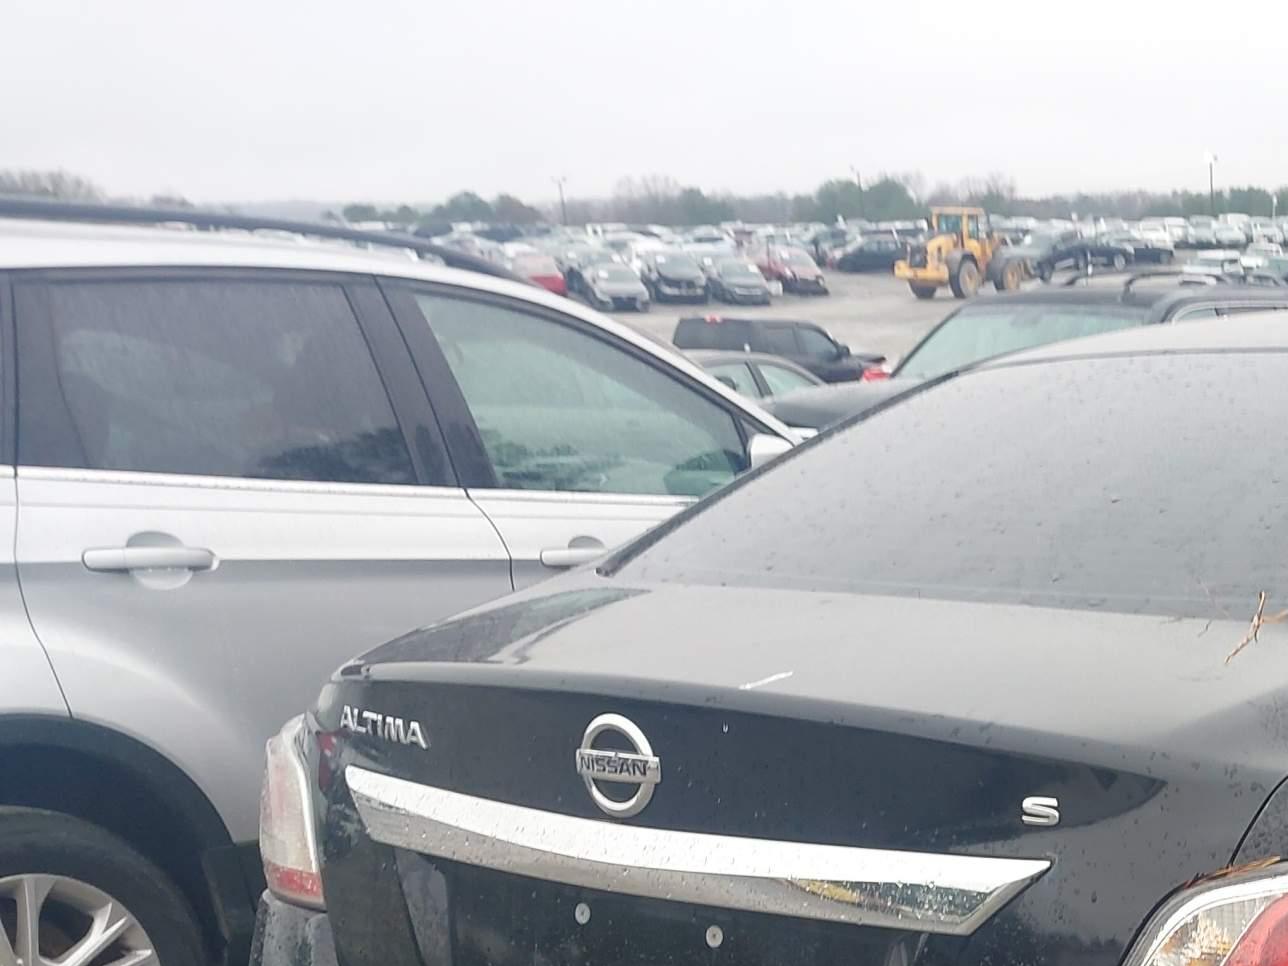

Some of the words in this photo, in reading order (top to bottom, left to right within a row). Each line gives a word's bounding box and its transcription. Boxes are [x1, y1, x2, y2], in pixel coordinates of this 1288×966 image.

[340, 704, 429, 750] ALTIMA
[580, 756, 649, 777] NISSAN
[1021, 795, 1060, 827] S
